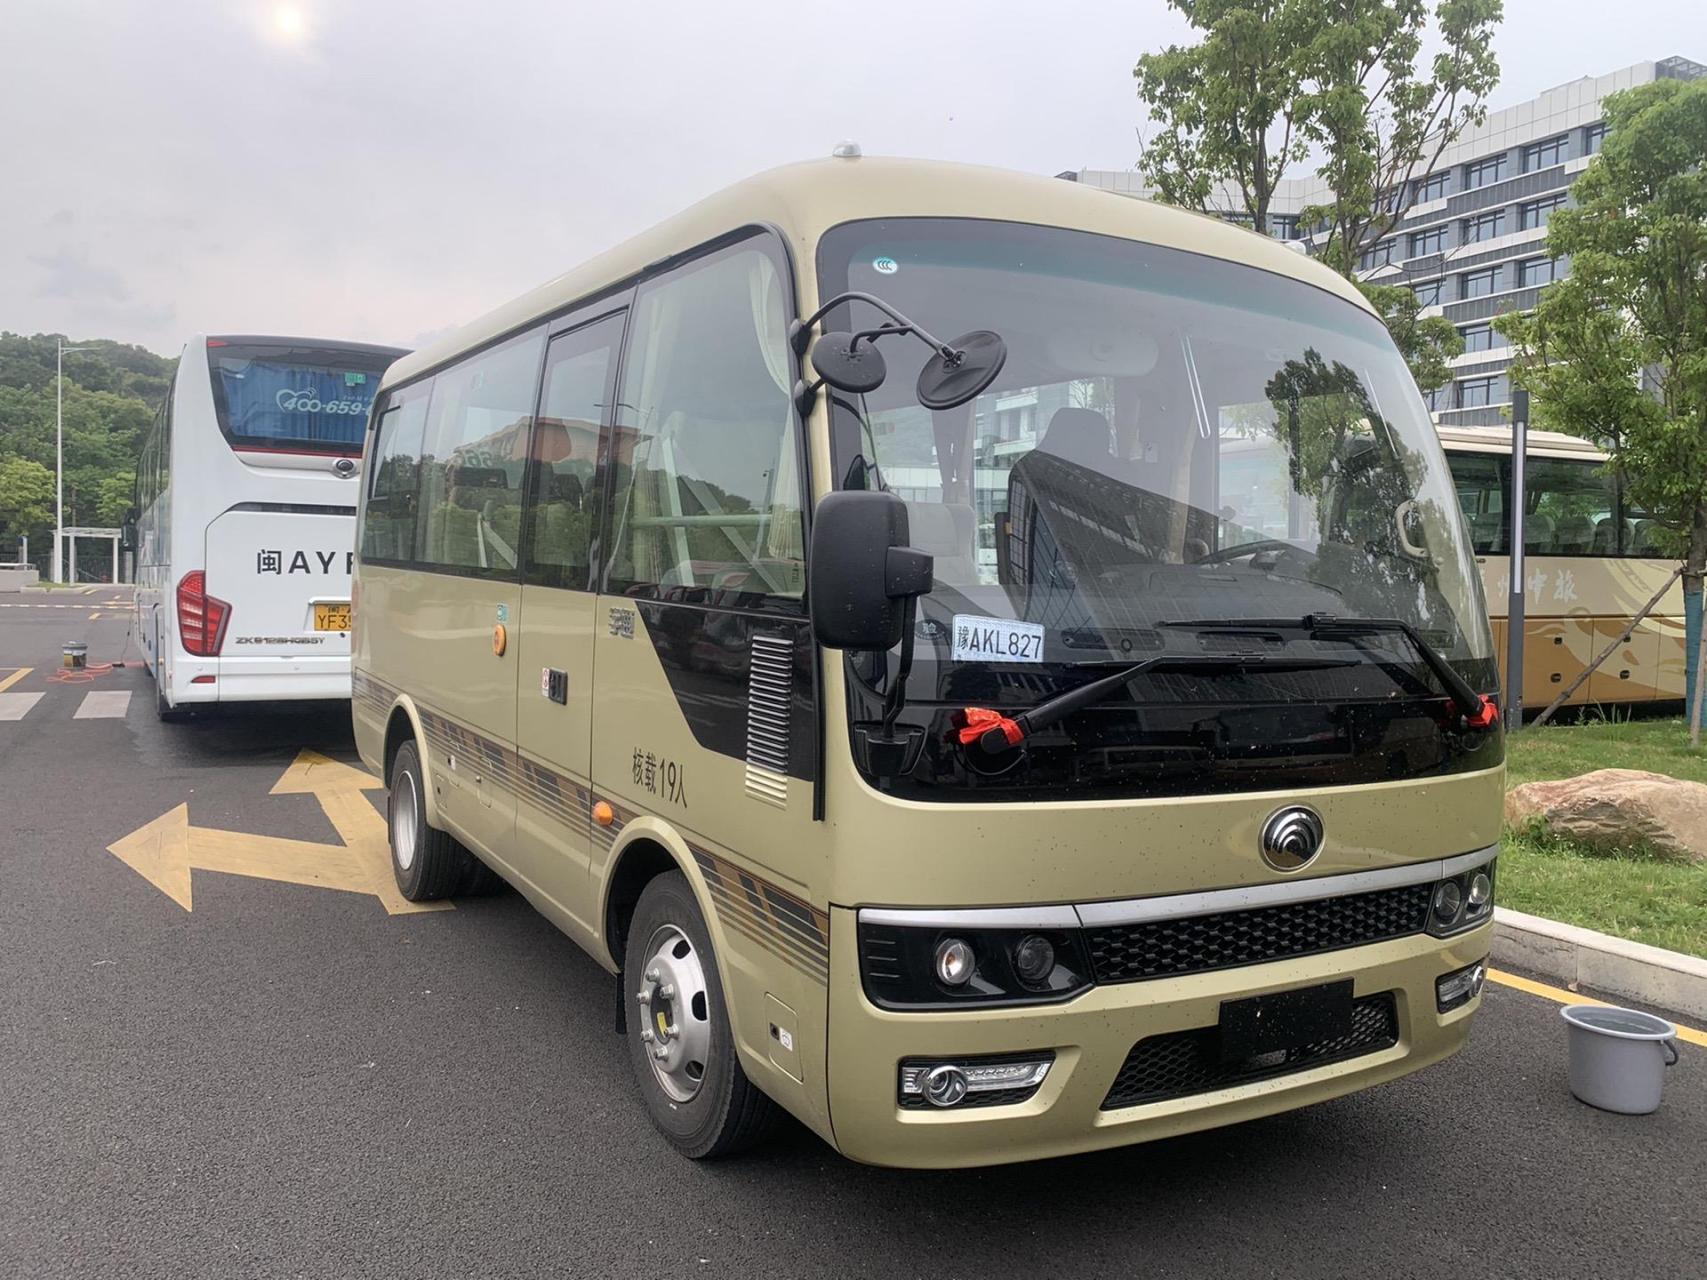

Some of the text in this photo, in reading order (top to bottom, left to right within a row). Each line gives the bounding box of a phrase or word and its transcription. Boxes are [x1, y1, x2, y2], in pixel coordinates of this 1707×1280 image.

[283, 397, 370, 416] 400-659-
[957, 625, 1042, 659] 豫AKL827
[632, 746, 688, 809] 核载19人
